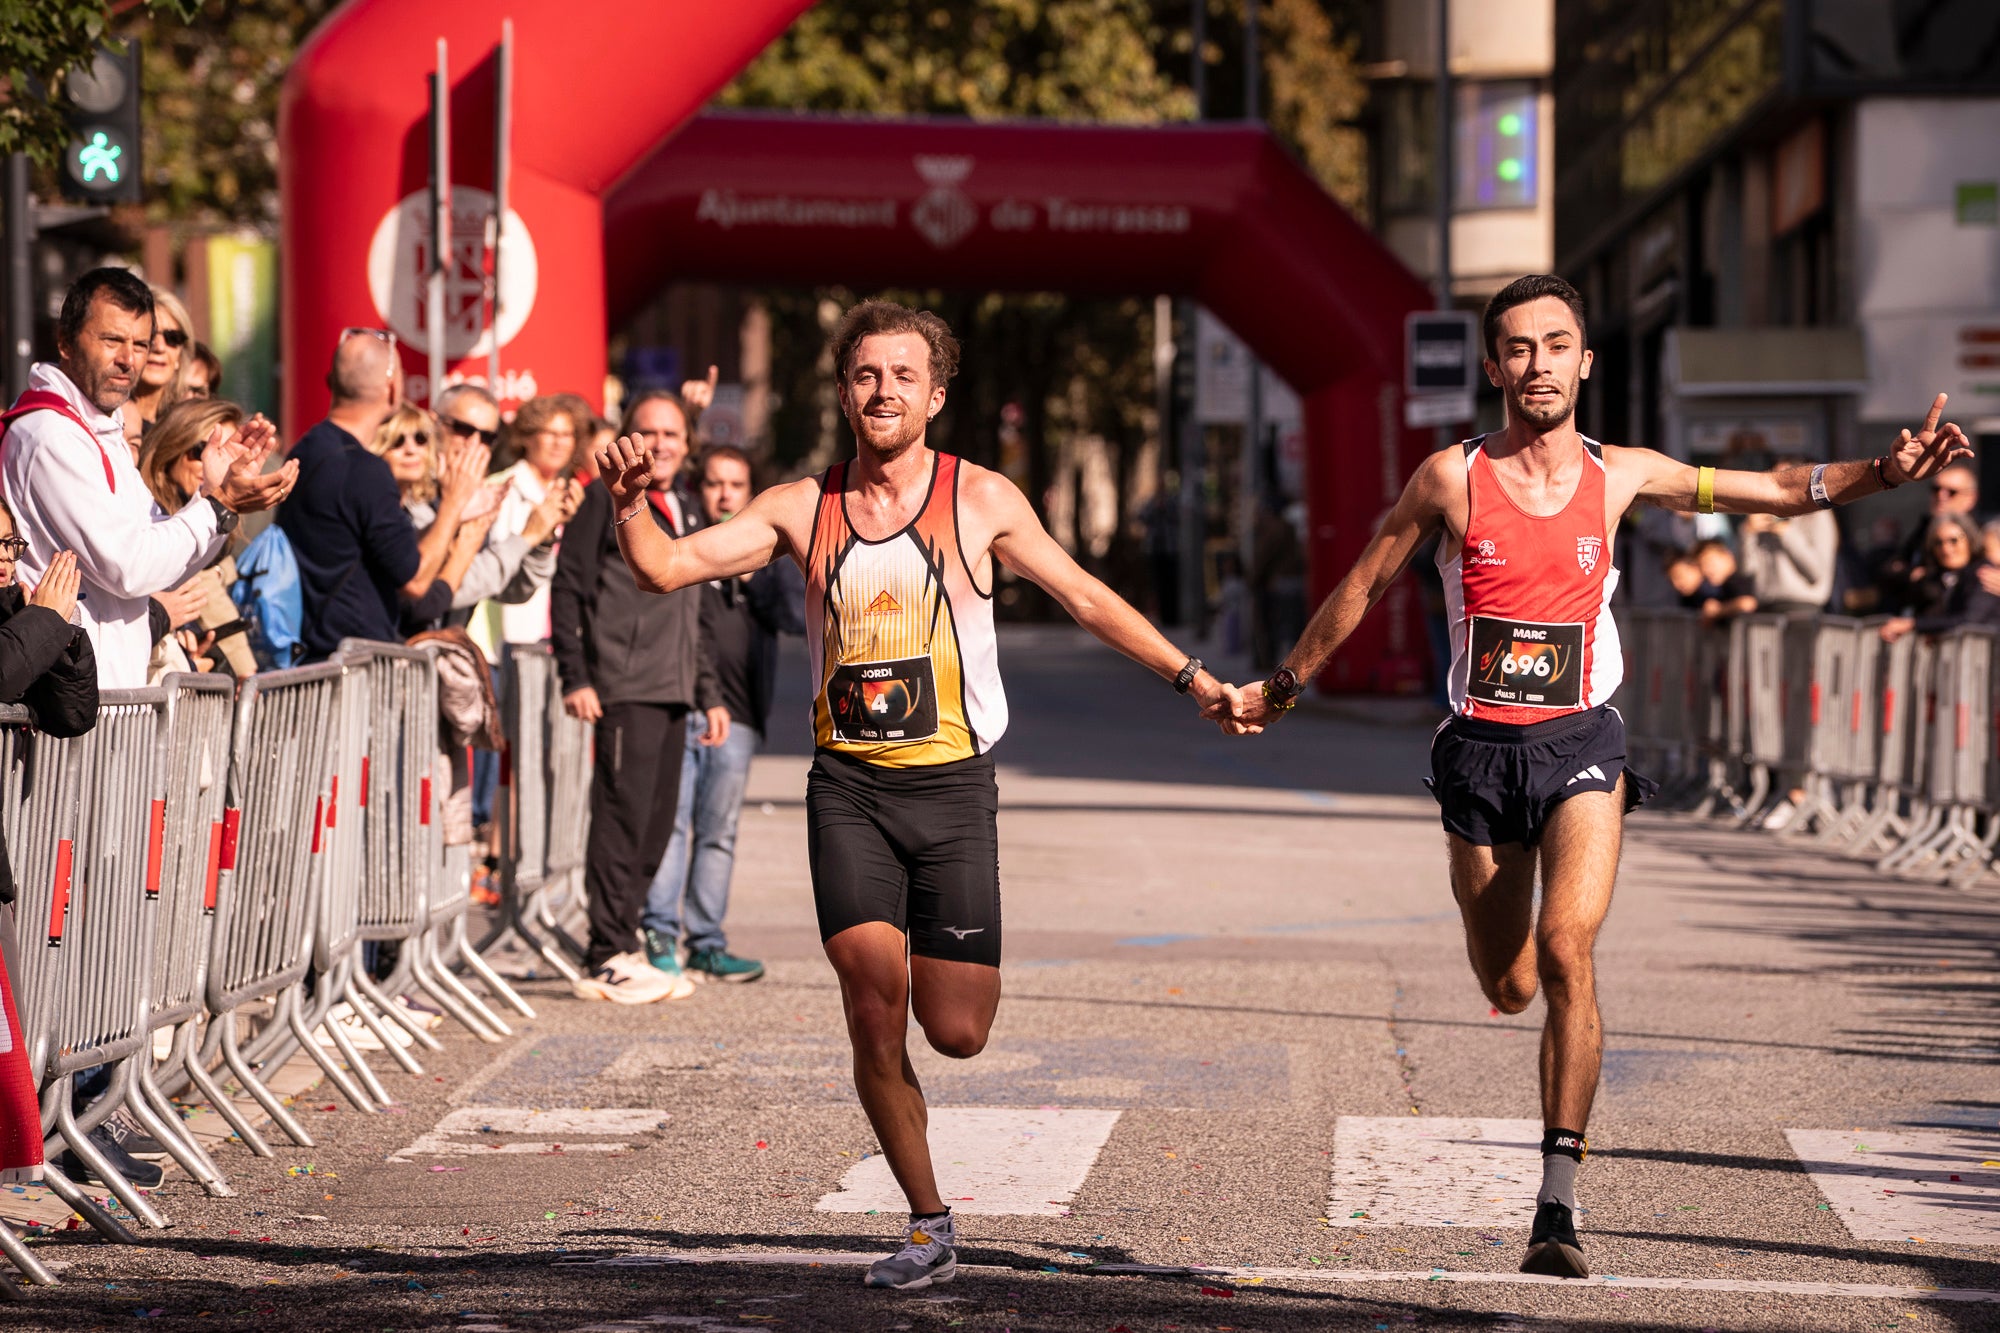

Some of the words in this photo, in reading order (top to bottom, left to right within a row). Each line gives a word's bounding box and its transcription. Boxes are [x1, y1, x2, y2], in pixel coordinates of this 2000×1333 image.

[697, 189, 896, 229] Ajuntament
[990, 196, 1036, 232] de
[1048, 196, 1190, 234] Terrassa
[1513, 628, 1547, 640] MARC
[861, 668, 893, 679] JORDI
[1501, 653, 1551, 677] 696
[871, 693, 888, 714] 4
